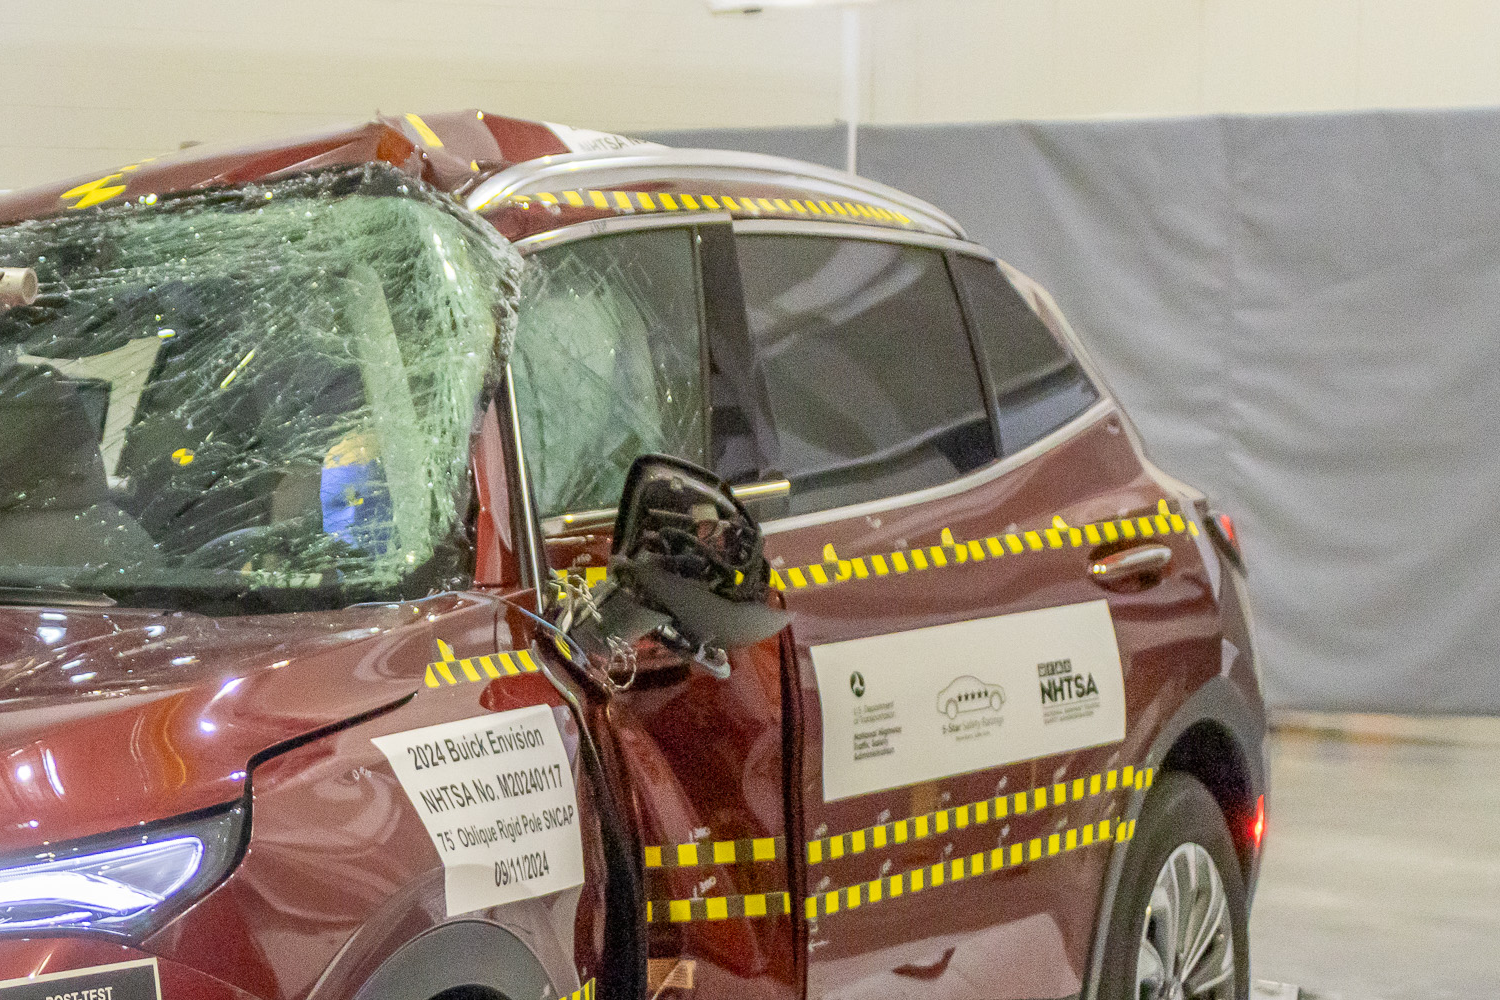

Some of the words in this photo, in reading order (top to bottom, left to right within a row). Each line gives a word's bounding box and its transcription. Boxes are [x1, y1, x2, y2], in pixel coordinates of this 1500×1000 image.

[1040, 672, 1099, 704] NHTSA
[407, 741, 447, 771] 2024
[443, 733, 489, 763] Buick
[486, 724, 545, 755] Envision
[419, 781, 477, 815] NHTSA
[471, 778, 500, 804] No.
[496, 763, 563, 799] M20240117
[457, 826, 497, 849] Oblique
[496, 815, 522, 843] Rigid
[522, 813, 543, 833] Pole
[542, 804, 574, 830] SNCAP
[494, 850, 550, 887] 09/11/2024
